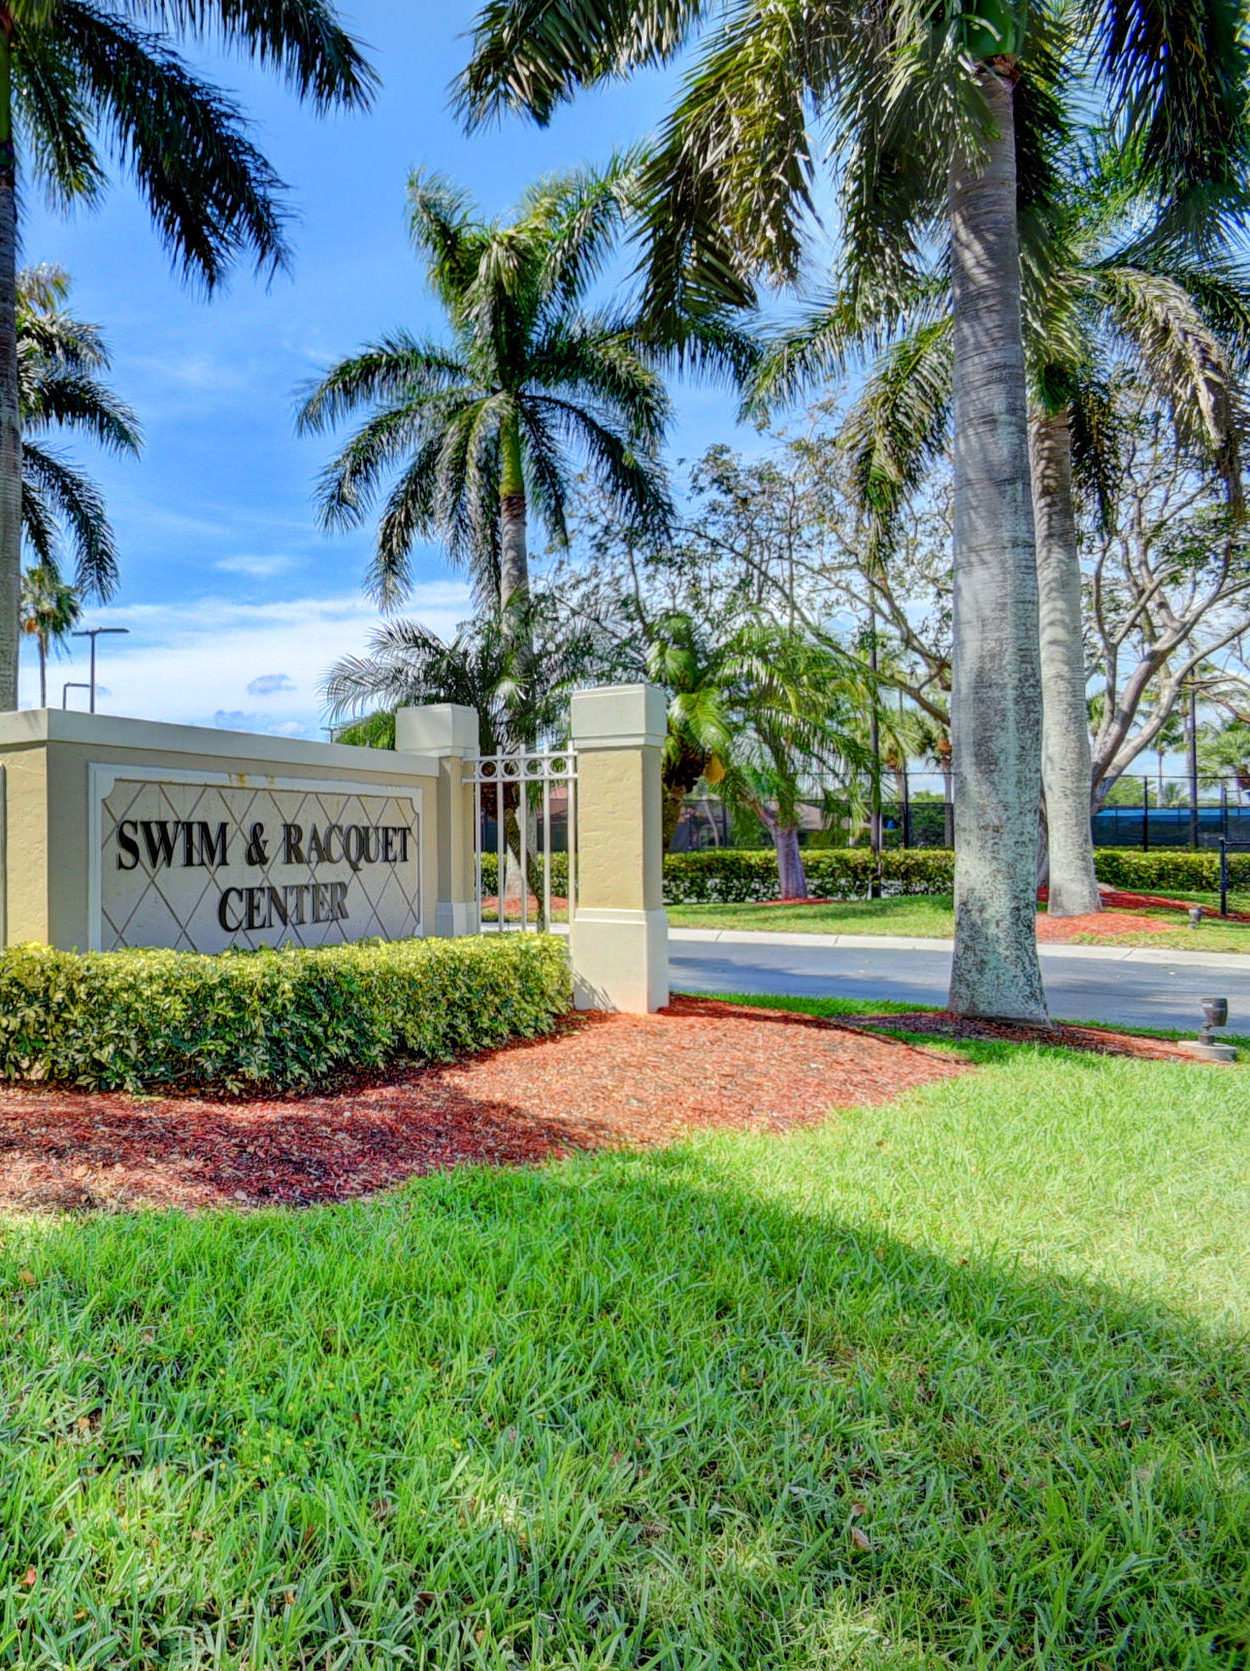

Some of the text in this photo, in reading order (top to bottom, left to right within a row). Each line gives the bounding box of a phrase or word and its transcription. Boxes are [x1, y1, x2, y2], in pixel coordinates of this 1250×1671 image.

[117, 820, 411, 872] SWIM & RACQUET
[218, 881, 349, 932] CENTER
